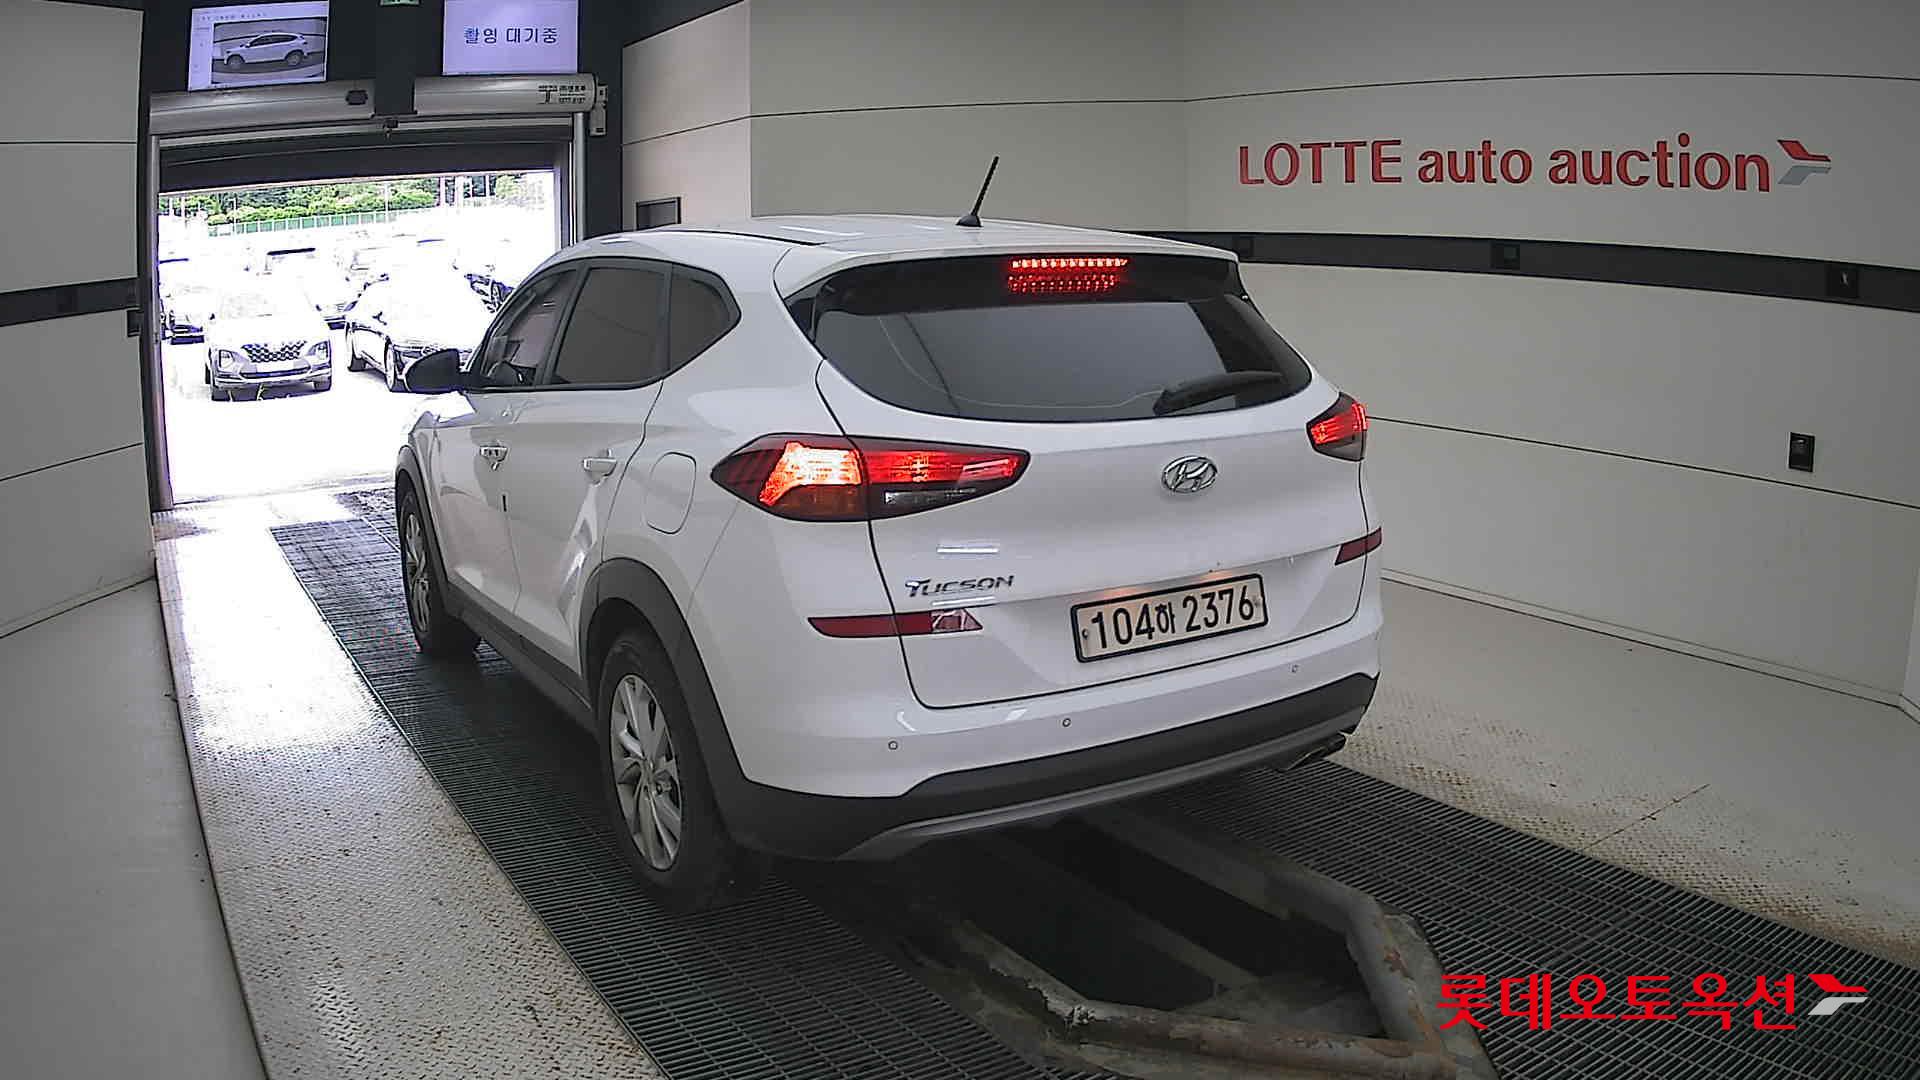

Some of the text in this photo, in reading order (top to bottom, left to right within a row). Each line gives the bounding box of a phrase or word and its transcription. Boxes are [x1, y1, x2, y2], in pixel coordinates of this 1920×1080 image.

[506, 27, 558, 44] 대기중
[1239, 133, 1771, 193] LOTTE auto auction
[905, 575, 1015, 598] TUCSON
[1091, 585, 1254, 649] 104하 2376
